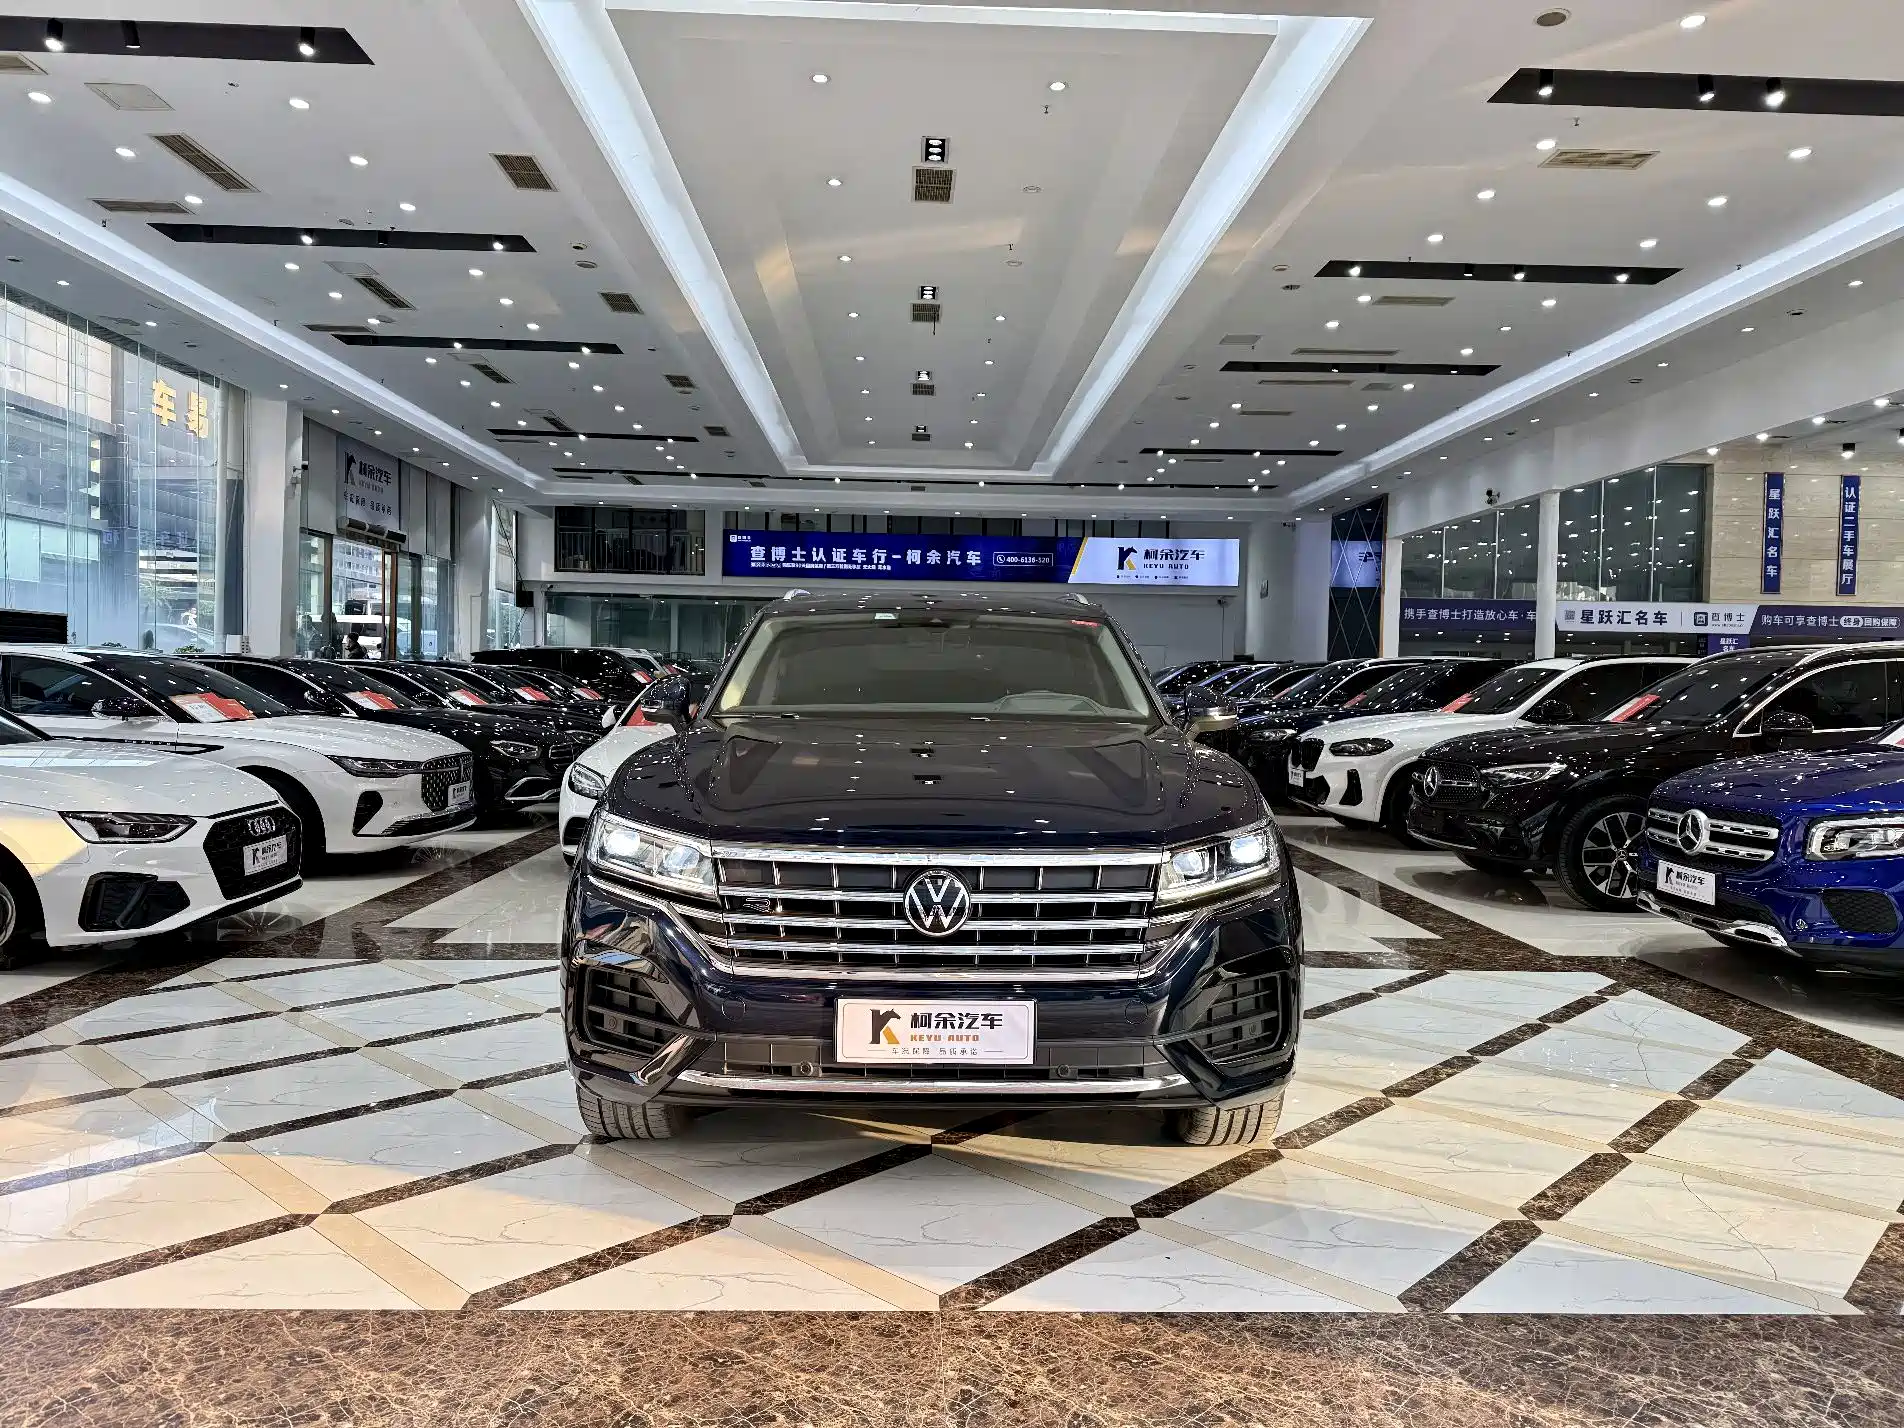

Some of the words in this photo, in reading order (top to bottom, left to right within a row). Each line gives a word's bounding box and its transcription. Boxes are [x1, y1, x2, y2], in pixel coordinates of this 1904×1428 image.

[1766, 488, 1781, 578] 星跃汇名车
[1841, 486, 1857, 585] 认证二手车展厅
[1143, 549, 1205, 561] 柯余汽车
[1580, 609, 1668, 626] 星跃汇名车
[1711, 612, 1745, 622] 查博士
[910, 1012, 1003, 1030] 柯余汽车
[910, 1034, 942, 1042] KEYU
[947, 1034, 979, 1042] AUTO
